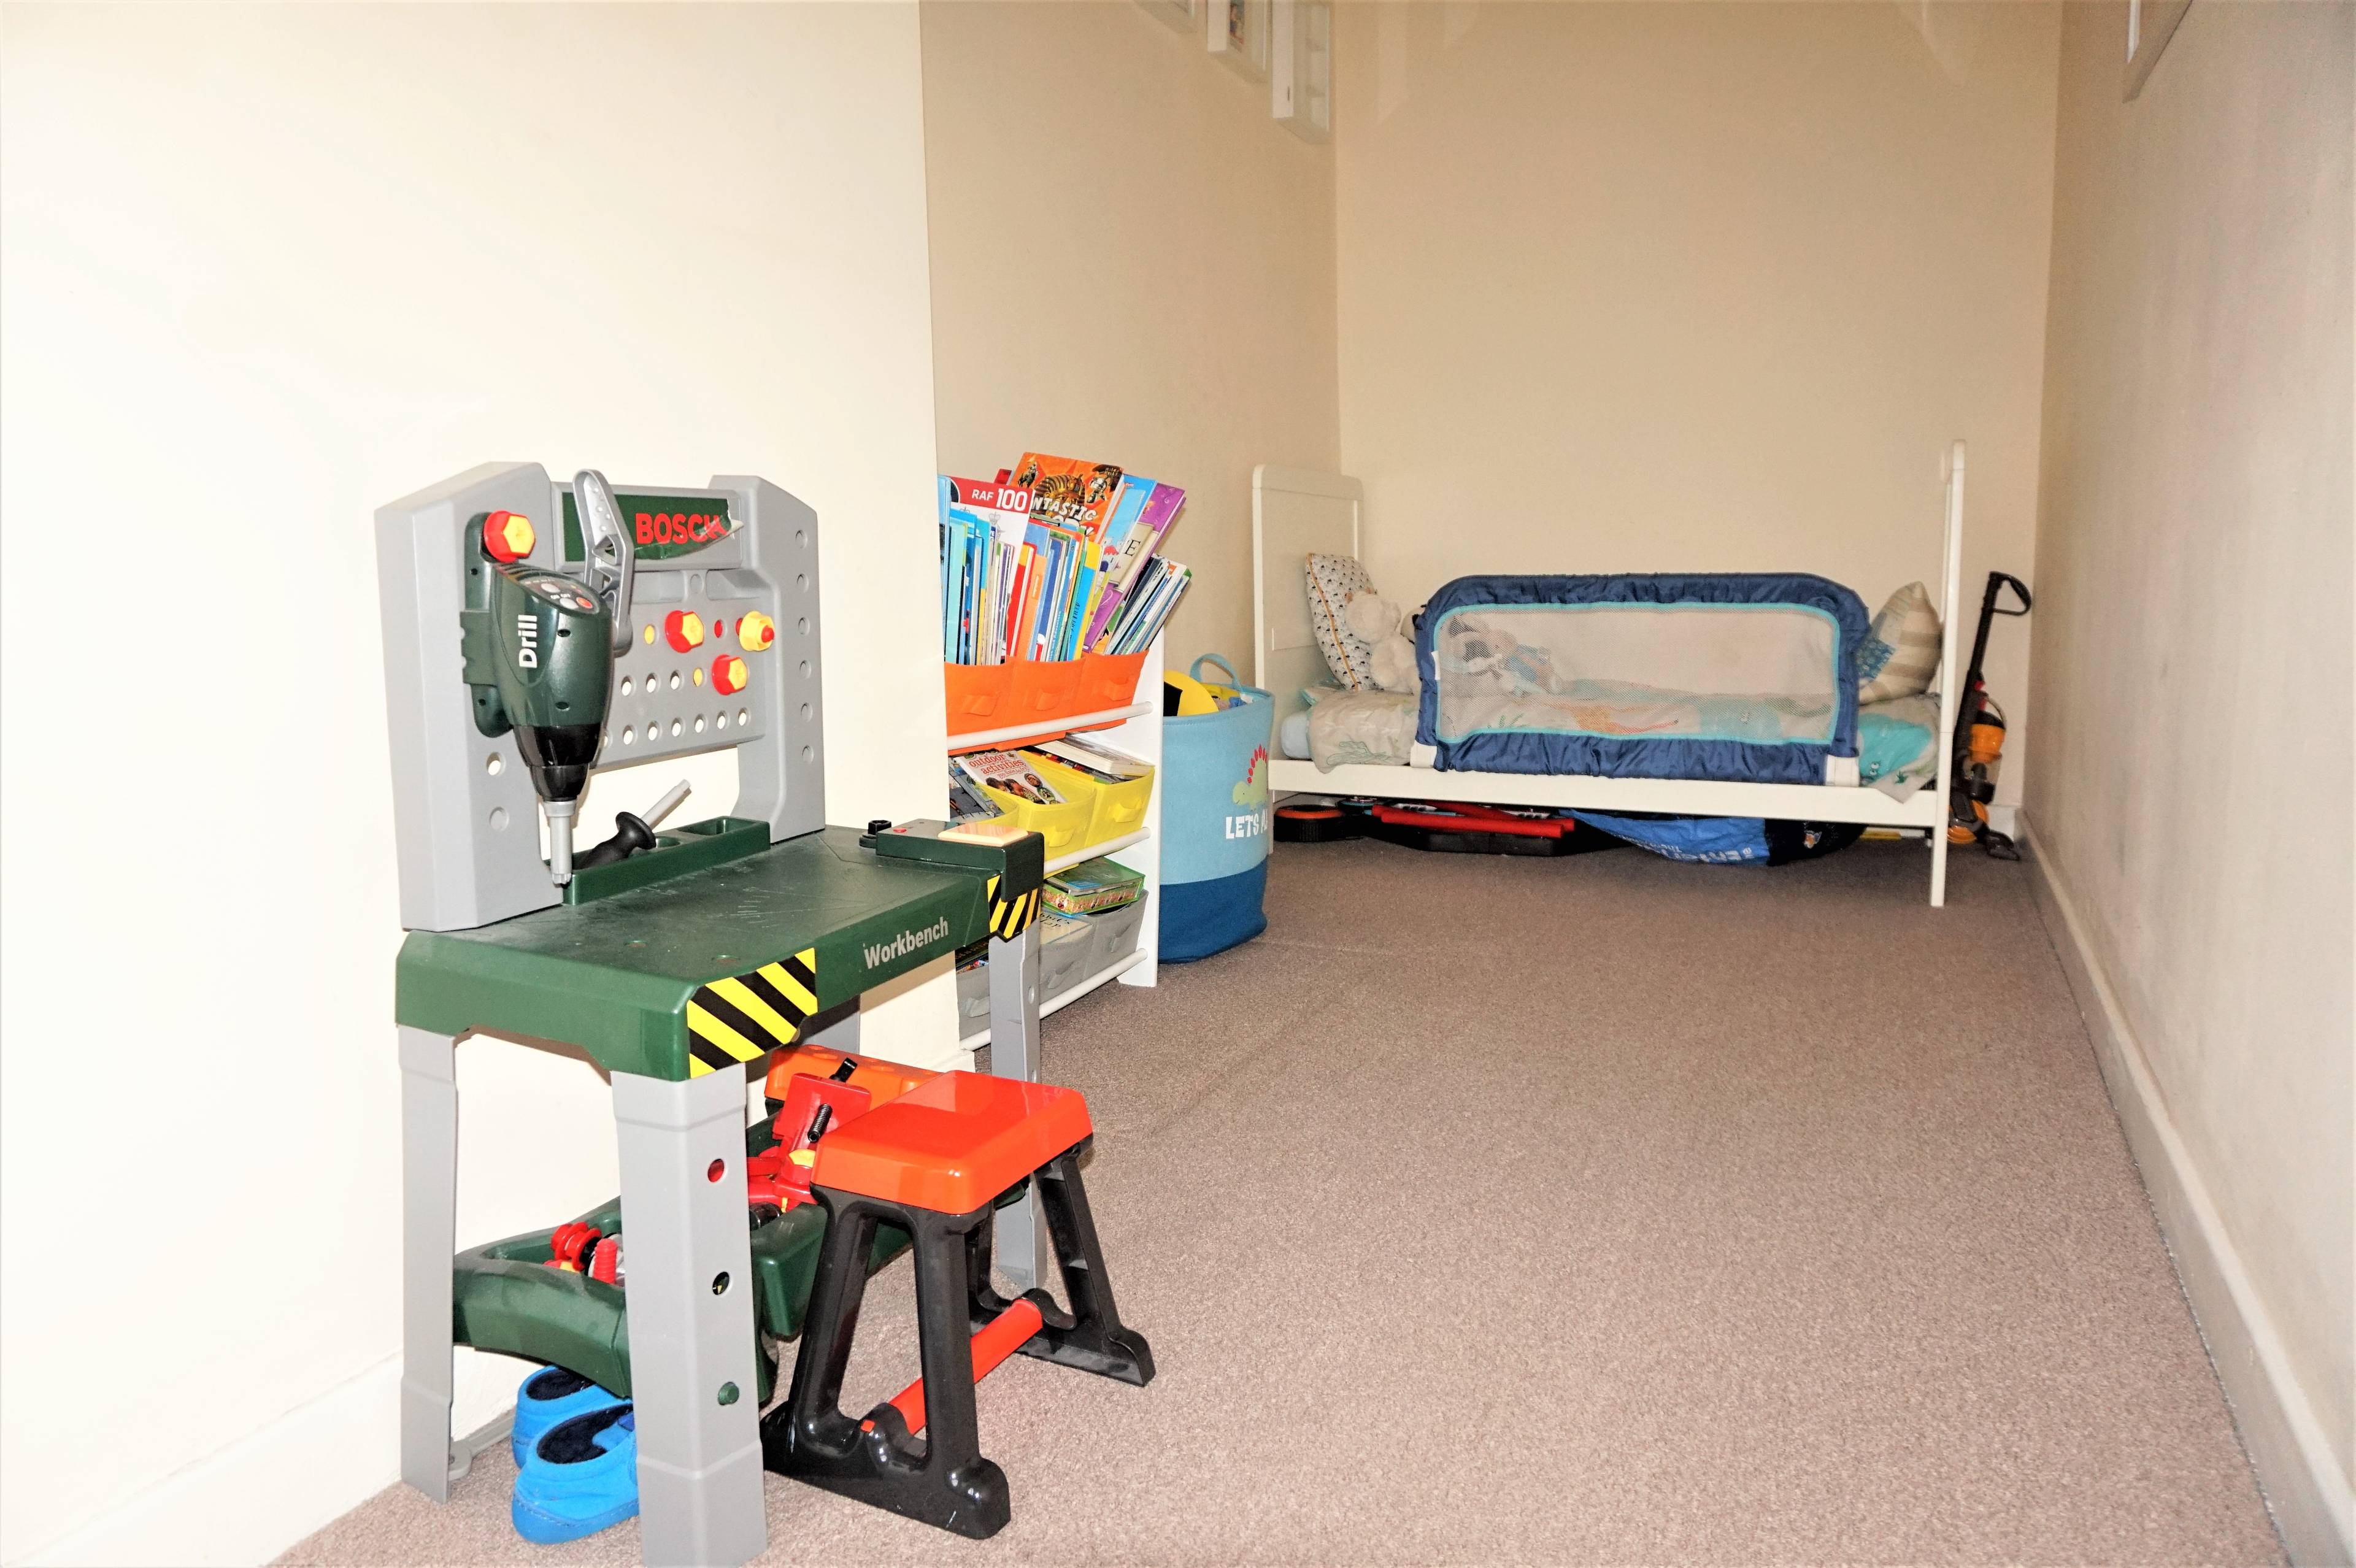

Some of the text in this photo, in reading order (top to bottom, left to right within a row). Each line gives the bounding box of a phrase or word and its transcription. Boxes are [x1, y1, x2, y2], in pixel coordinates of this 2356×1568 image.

[972, 488, 1028, 511] RAF 100
[1032, 496, 1097, 521] NTASTIC
[635, 513, 728, 544] BOSCH
[518, 615, 537, 668] Drill
[969, 753, 1006, 768] outdoor
[980, 759, 1025, 774] activities
[1226, 813, 1259, 839] LETS
[864, 917, 949, 969] Workbench
